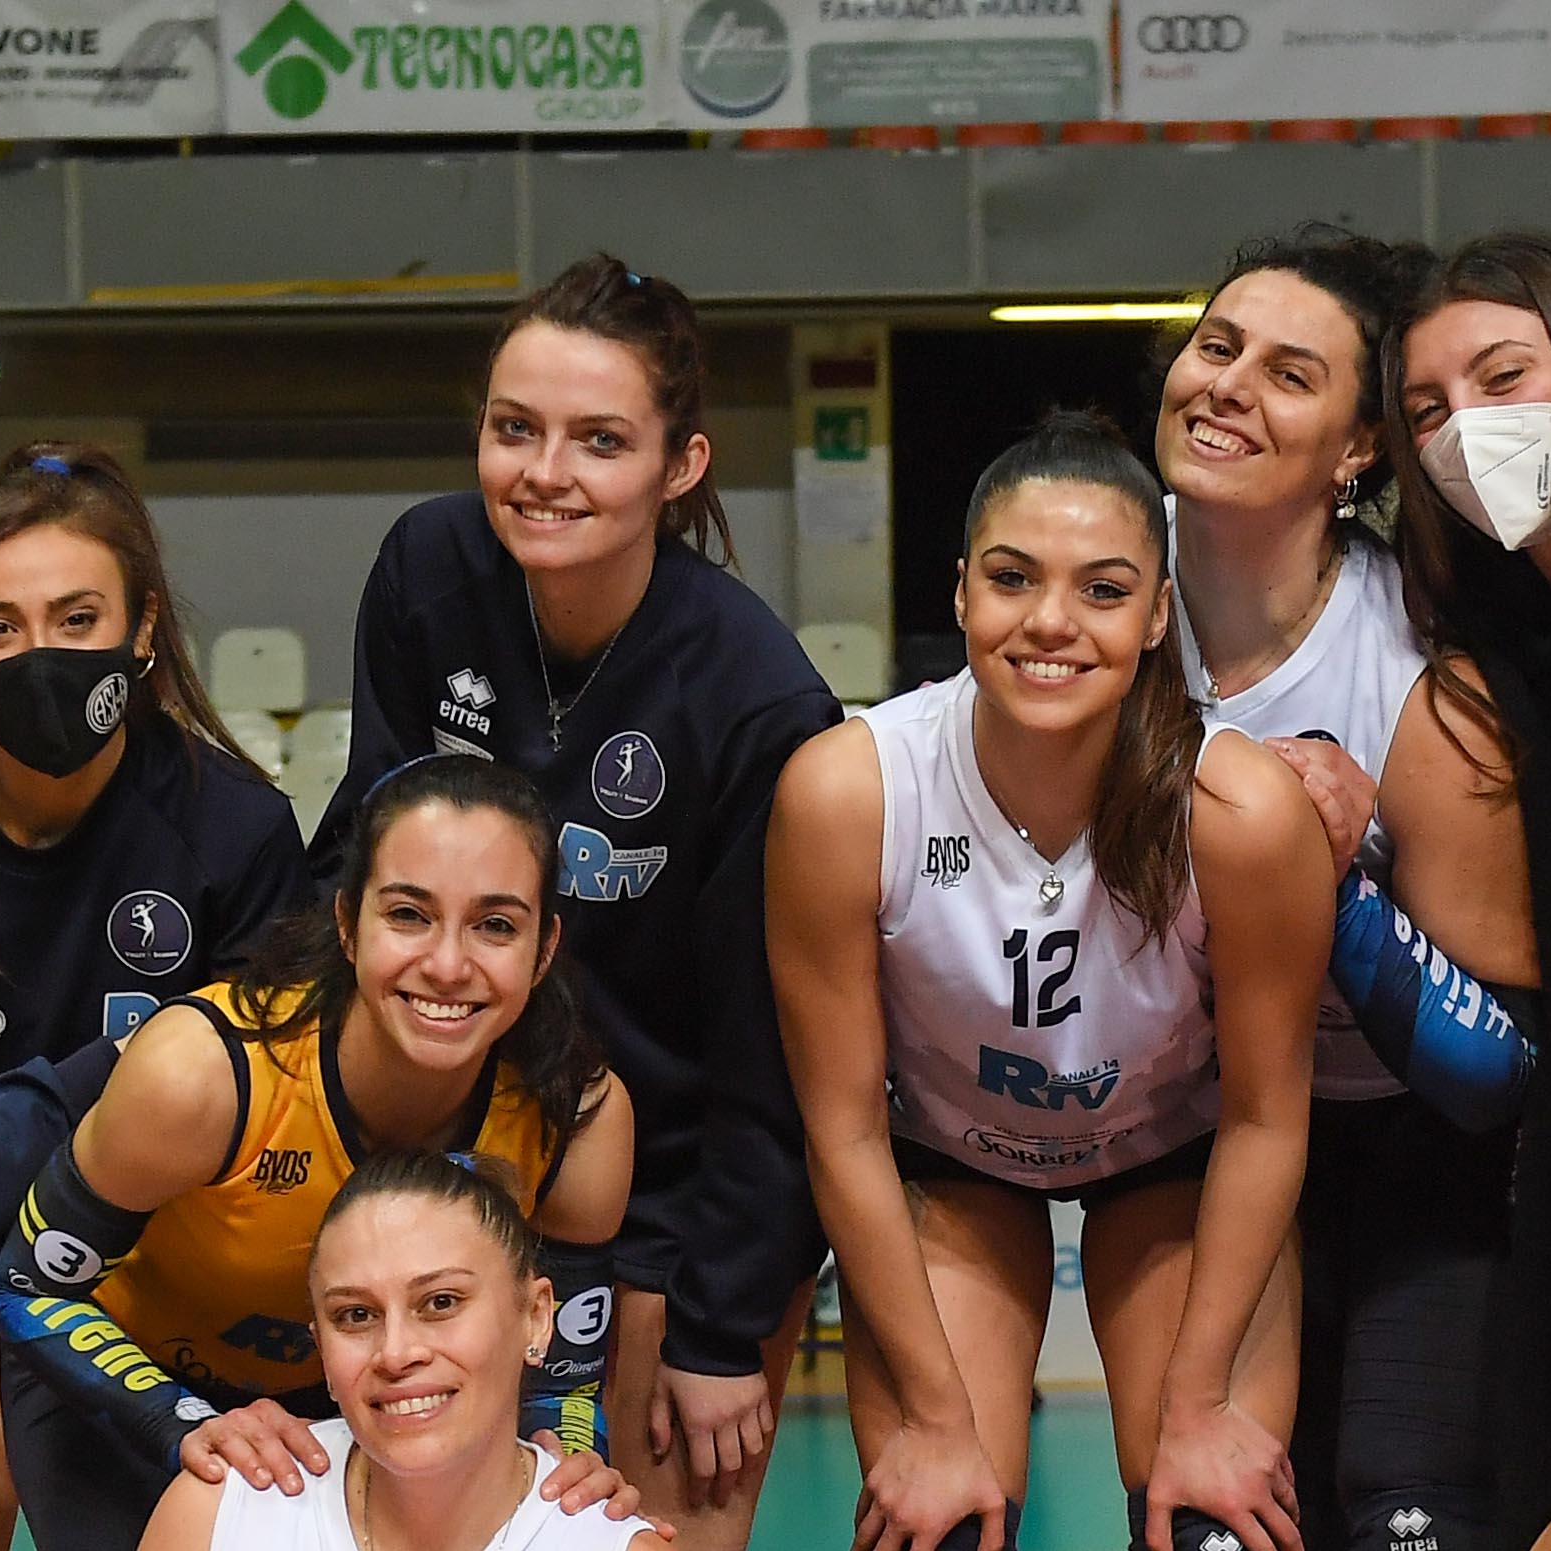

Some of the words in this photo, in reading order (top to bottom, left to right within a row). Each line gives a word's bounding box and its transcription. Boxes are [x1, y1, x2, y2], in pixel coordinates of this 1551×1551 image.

[354, 24, 644, 90] TECNOCASA
[439, 700, 491, 735] errea
[927, 835, 971, 873] BVOS
[1002, 928, 1082, 1028] 12
[1051, 1066, 1099, 1083] CANALE
[1101, 1059, 1120, 1076] 14
[255, 1148, 312, 1185] BVOS
[46, 1240, 88, 1278] 3
[576, 1294, 605, 1337] 3
